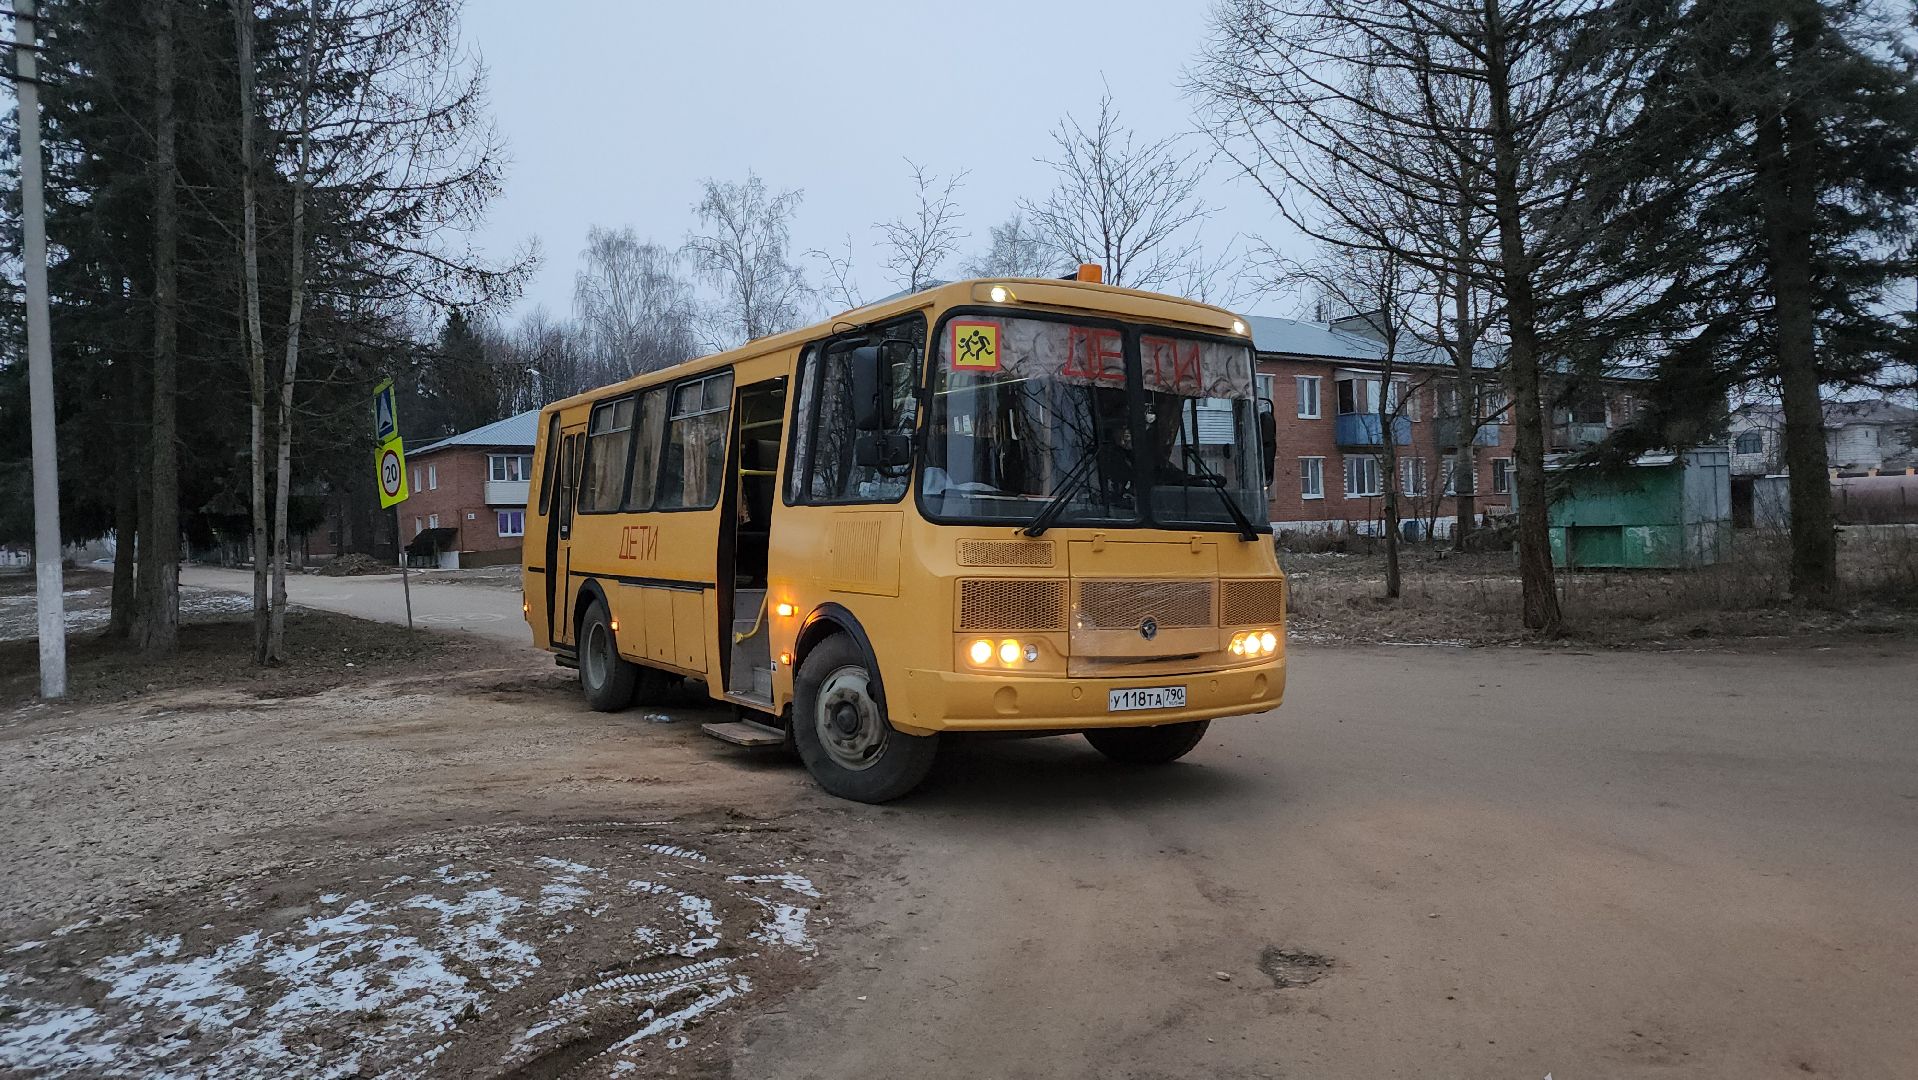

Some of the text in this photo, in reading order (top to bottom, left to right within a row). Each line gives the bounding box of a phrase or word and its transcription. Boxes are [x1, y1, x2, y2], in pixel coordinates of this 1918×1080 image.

[1063, 326, 1202, 391] ДЕТИ
[385, 464, 397, 483] 20
[619, 526, 658, 560] ДЕТИ
